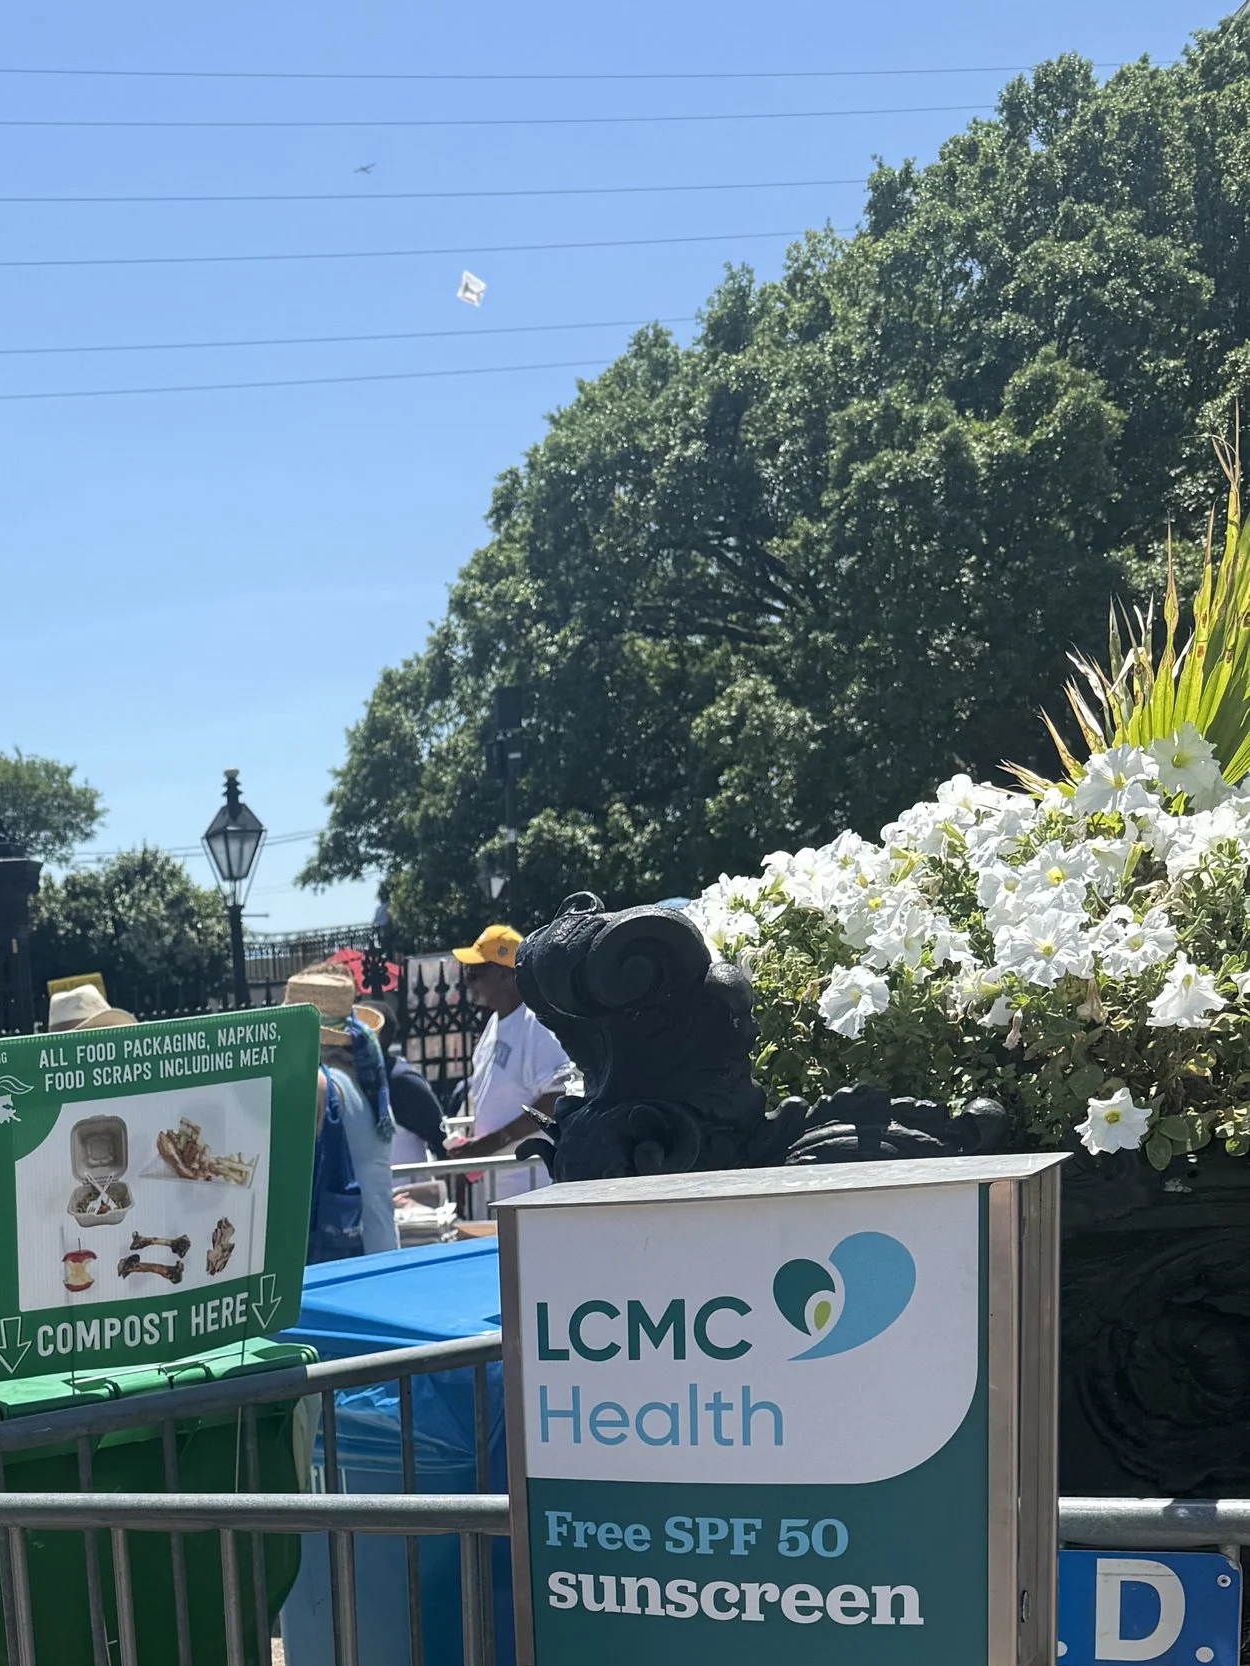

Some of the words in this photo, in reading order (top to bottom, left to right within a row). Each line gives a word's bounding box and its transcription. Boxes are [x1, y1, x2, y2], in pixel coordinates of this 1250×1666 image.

[38, 1049, 69, 1069] ALL
[76, 1042, 116, 1065] FOOD
[124, 1030, 210, 1060] PACKAGING,
[217, 1022, 281, 1048] NAPKINS,
[45, 1070, 84, 1092] FOOD
[93, 1061, 152, 1087] SCRAPS
[159, 1051, 233, 1078] INCLUDING
[240, 1046, 277, 1067] MEAT
[36, 1309, 178, 1358] COMPOST
[191, 1291, 249, 1337] HERE
[536, 1296, 753, 1361] LCMC
[539, 1384, 784, 1447] Health
[544, 1510, 651, 1552] Free
[664, 1515, 762, 1556] SPF
[778, 1518, 849, 1559] 50
[548, 1568, 924, 1626] sunscreen
